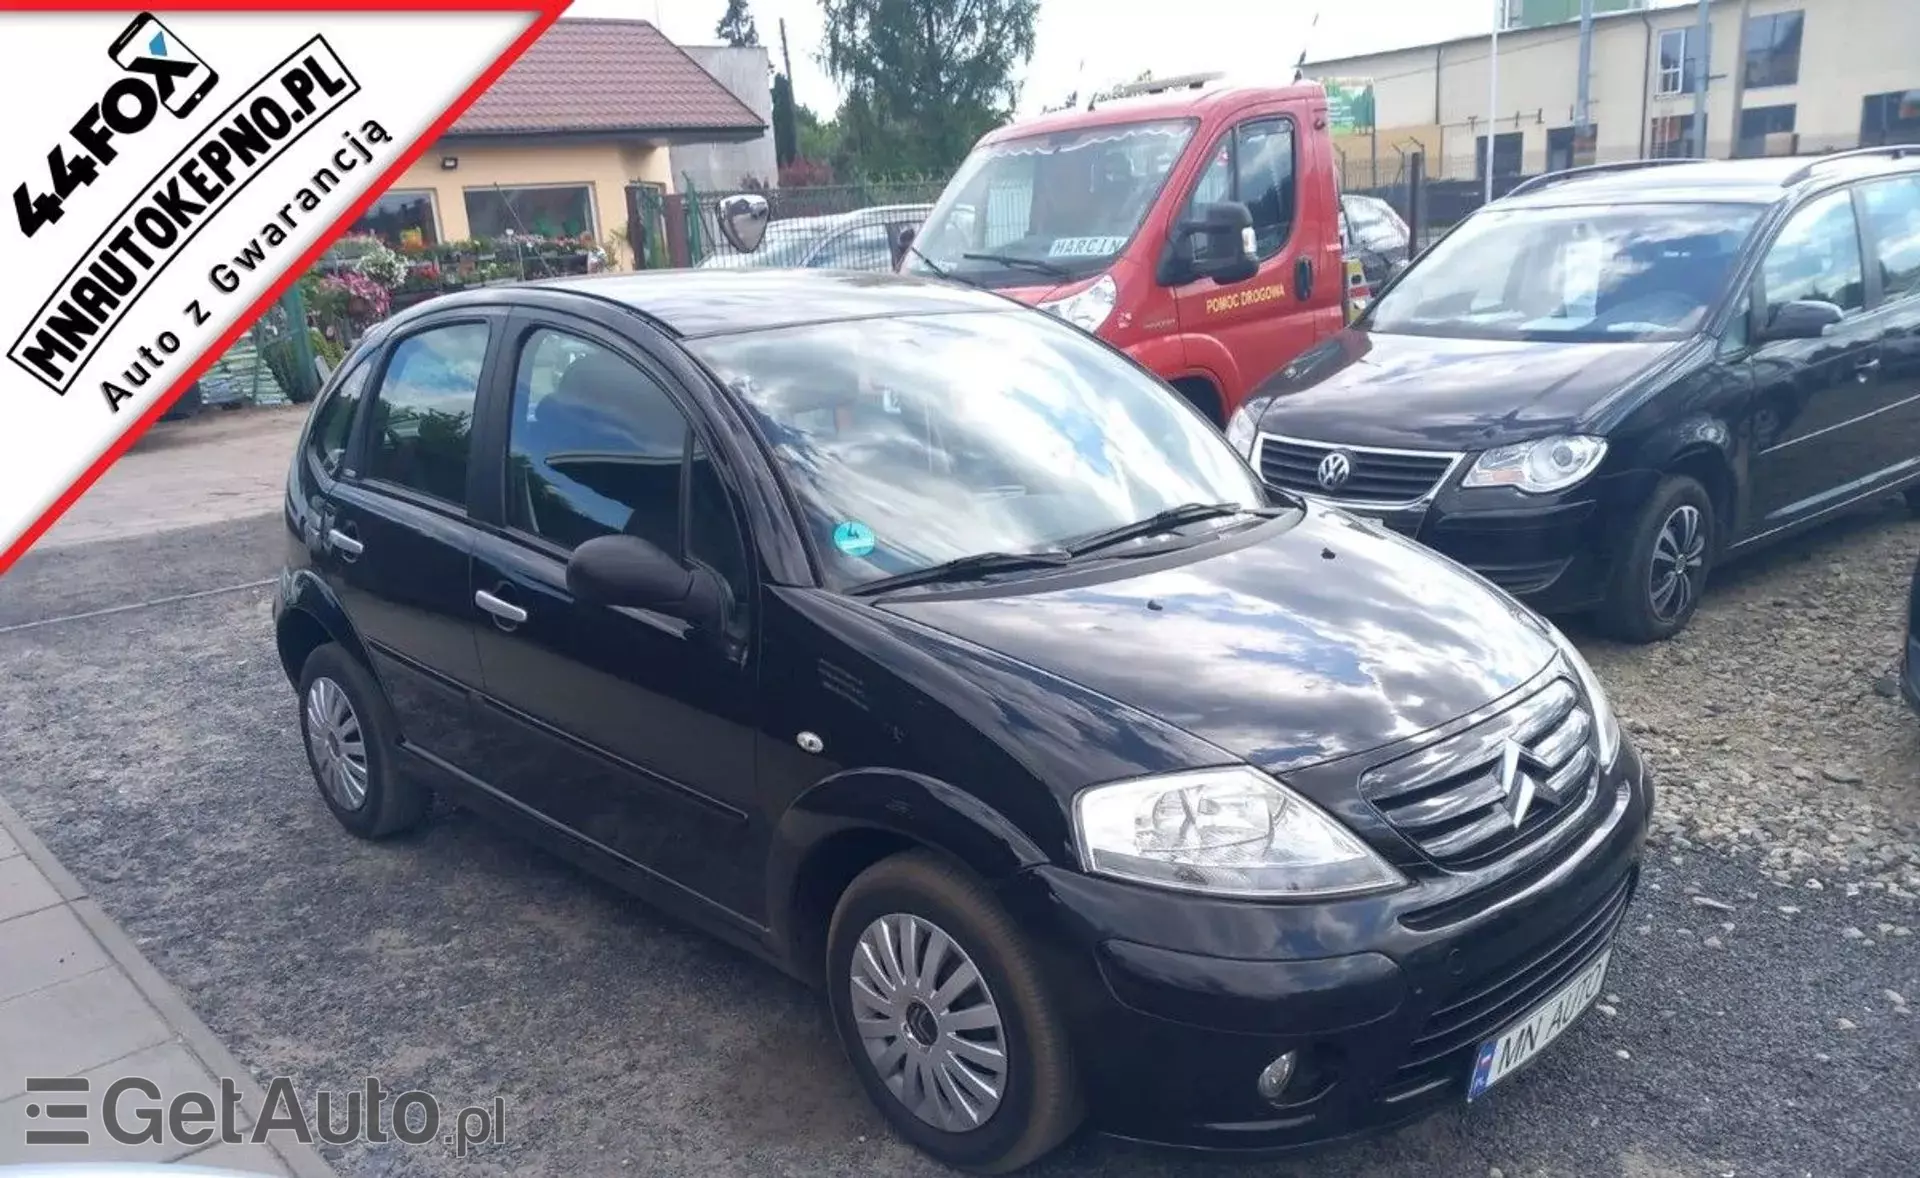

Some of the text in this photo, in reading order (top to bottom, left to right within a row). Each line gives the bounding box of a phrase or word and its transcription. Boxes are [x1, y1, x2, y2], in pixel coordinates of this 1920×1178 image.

[1053, 239, 1121, 255] MARCIN
[1206, 284, 1286, 313] POMOC DROGOWA
[1498, 1015, 1543, 1073] MN
